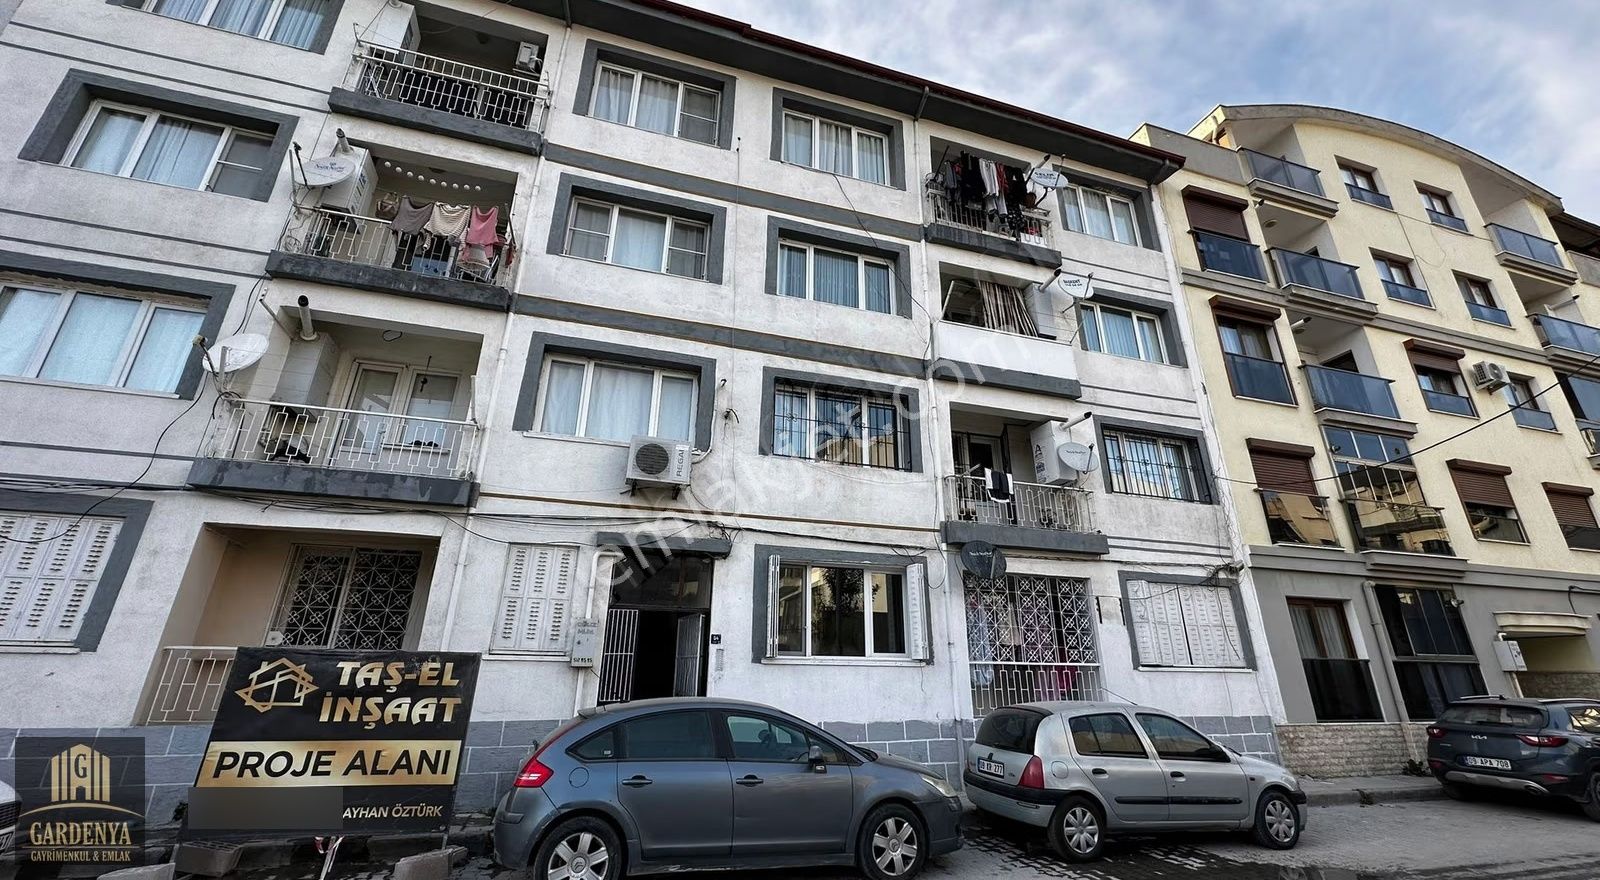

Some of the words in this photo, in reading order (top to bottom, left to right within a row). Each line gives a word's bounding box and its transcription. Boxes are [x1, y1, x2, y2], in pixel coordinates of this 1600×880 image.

[336, 661, 460, 693] TAŞ-EL
[319, 691, 462, 730] İNŞAAT
[212, 750, 337, 779] PROJE
[342, 749, 451, 776] ALANI
[342, 806, 389, 819] AYHAN
[391, 803, 444, 818] ÖZTÜRK
